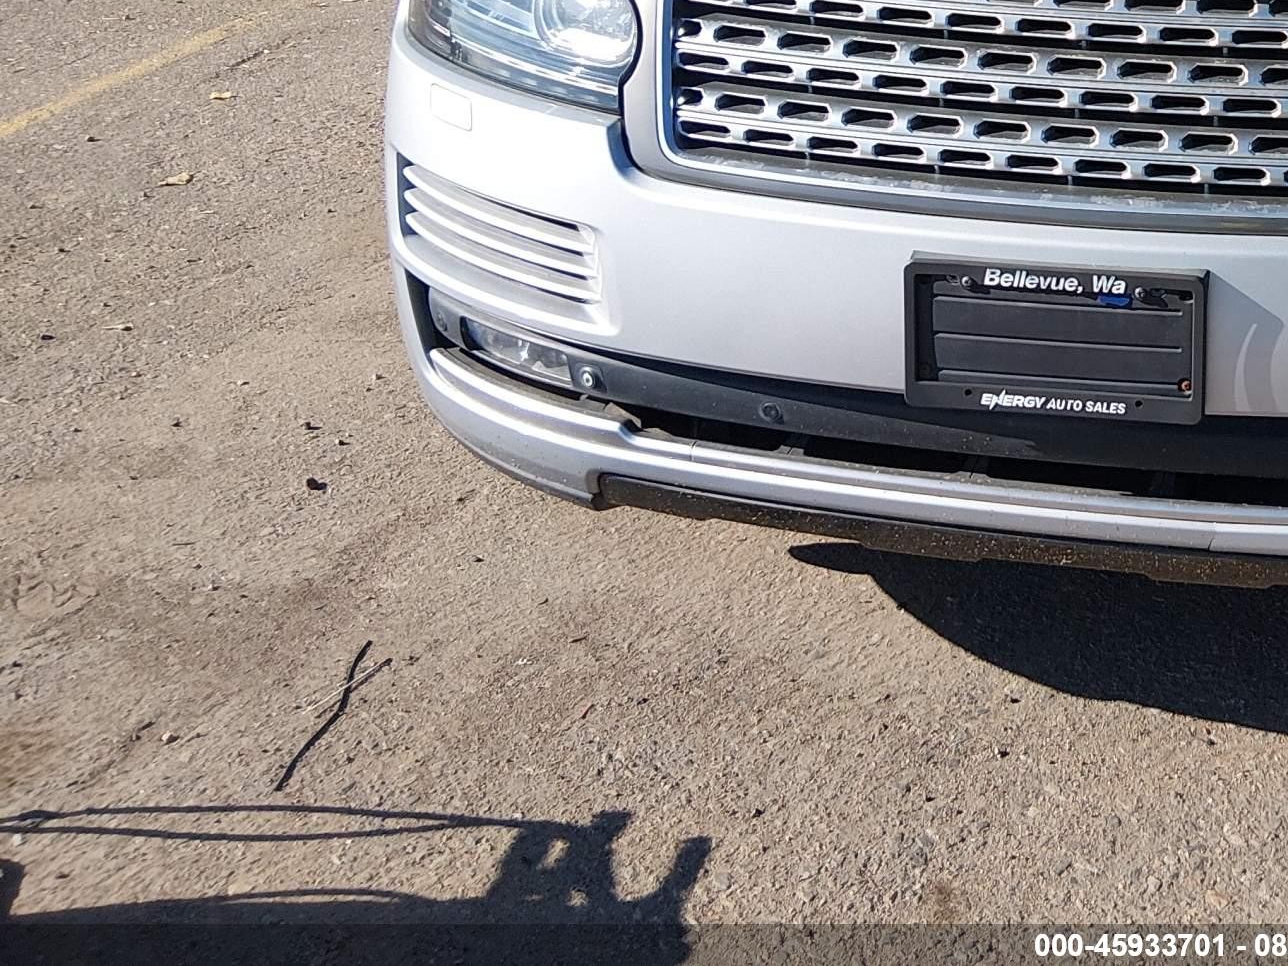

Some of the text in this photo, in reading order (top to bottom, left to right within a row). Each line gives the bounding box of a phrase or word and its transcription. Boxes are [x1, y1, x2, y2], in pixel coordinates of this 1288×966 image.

[983, 268, 1126, 294] Bellevue, Wa
[980, 389, 1126, 415] ENERGY AUTO SALES
